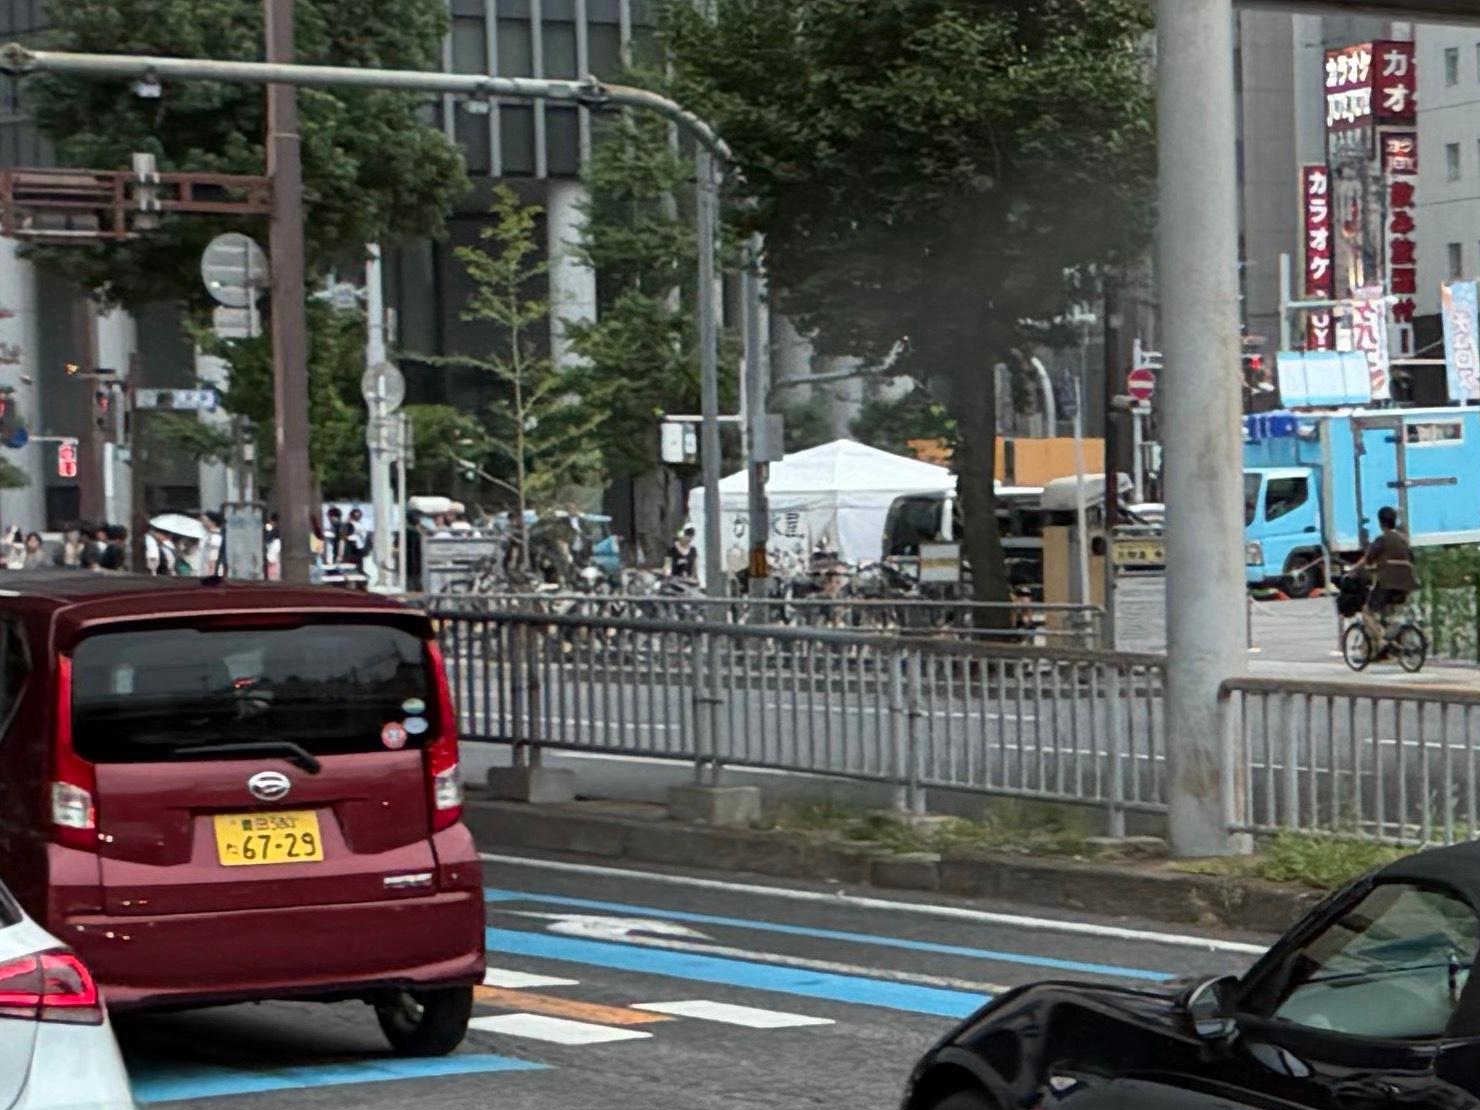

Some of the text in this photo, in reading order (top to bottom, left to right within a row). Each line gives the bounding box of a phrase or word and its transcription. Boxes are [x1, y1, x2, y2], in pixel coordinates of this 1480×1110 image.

[1308, 171, 1330, 280] カラオケ
[243, 832, 317, 860] 67-29
